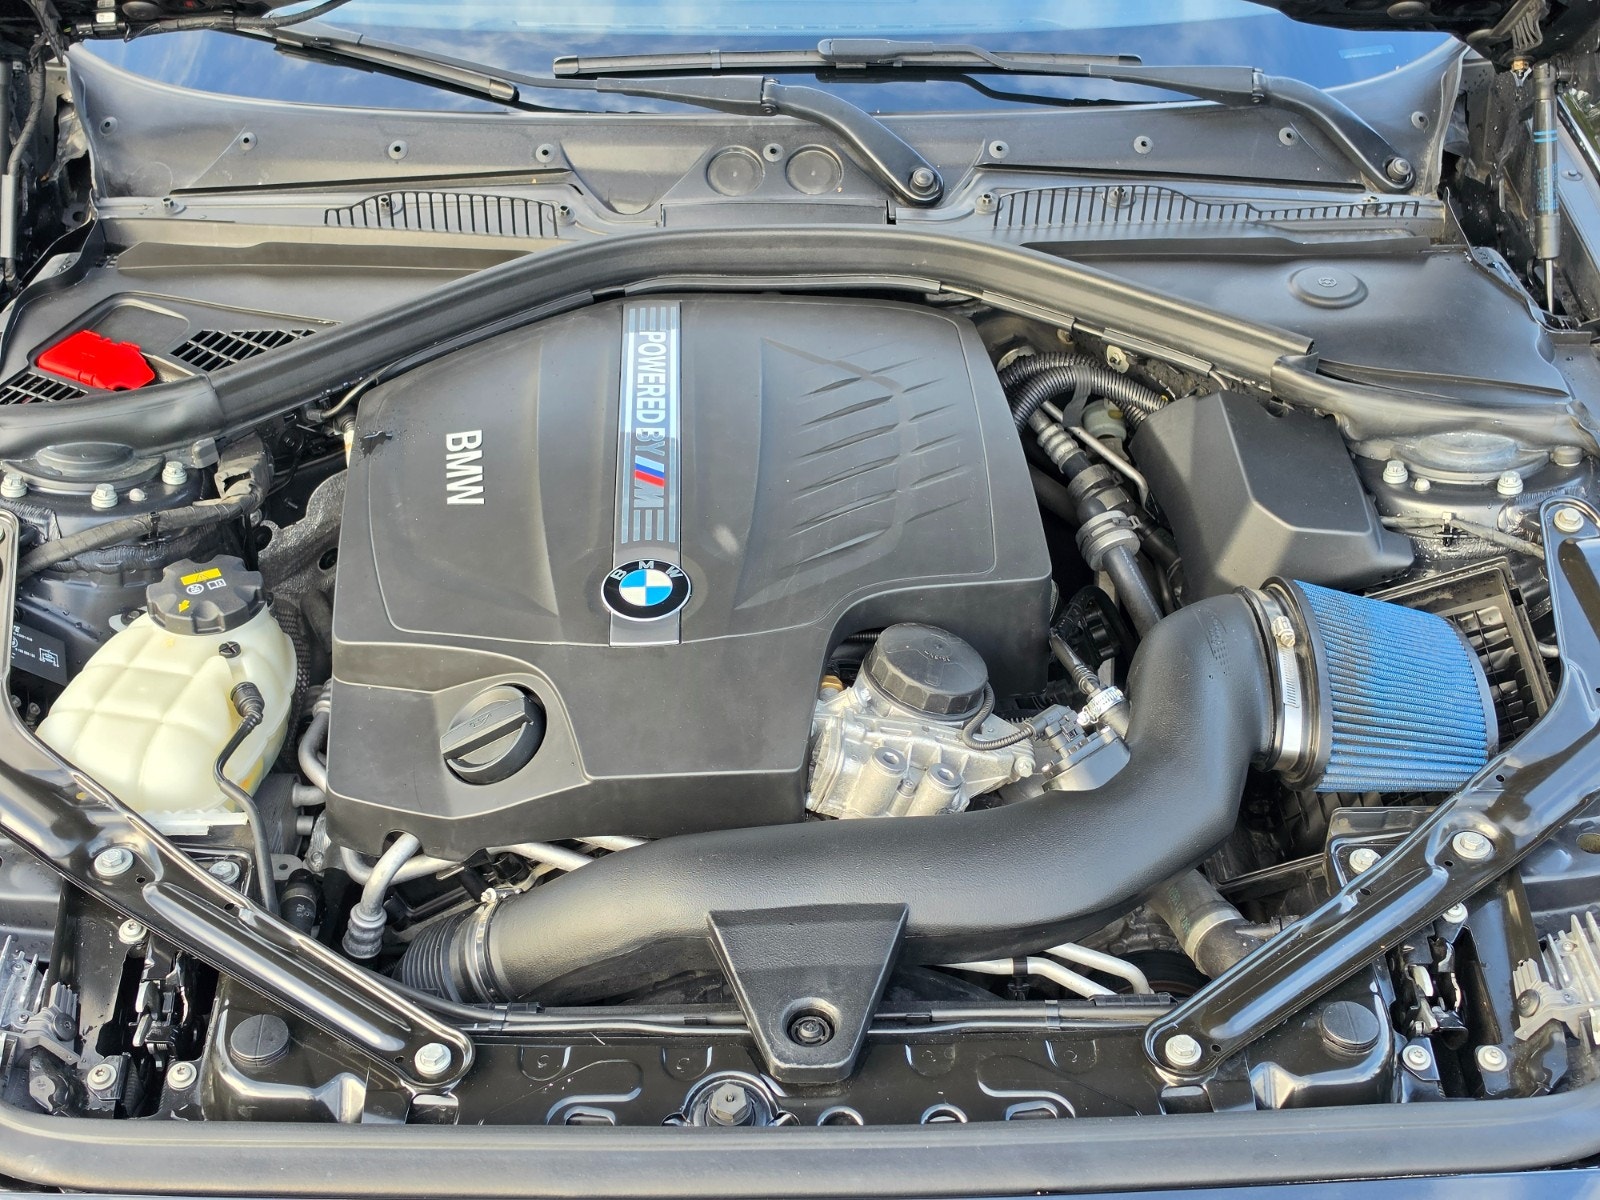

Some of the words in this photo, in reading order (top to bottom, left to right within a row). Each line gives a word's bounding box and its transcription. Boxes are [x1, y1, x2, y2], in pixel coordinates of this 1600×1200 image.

[636, 331, 666, 424] POWERED
[446, 429, 485, 505] BMW
[635, 427, 665, 456] BY
[610, 560, 684, 581] BMW
